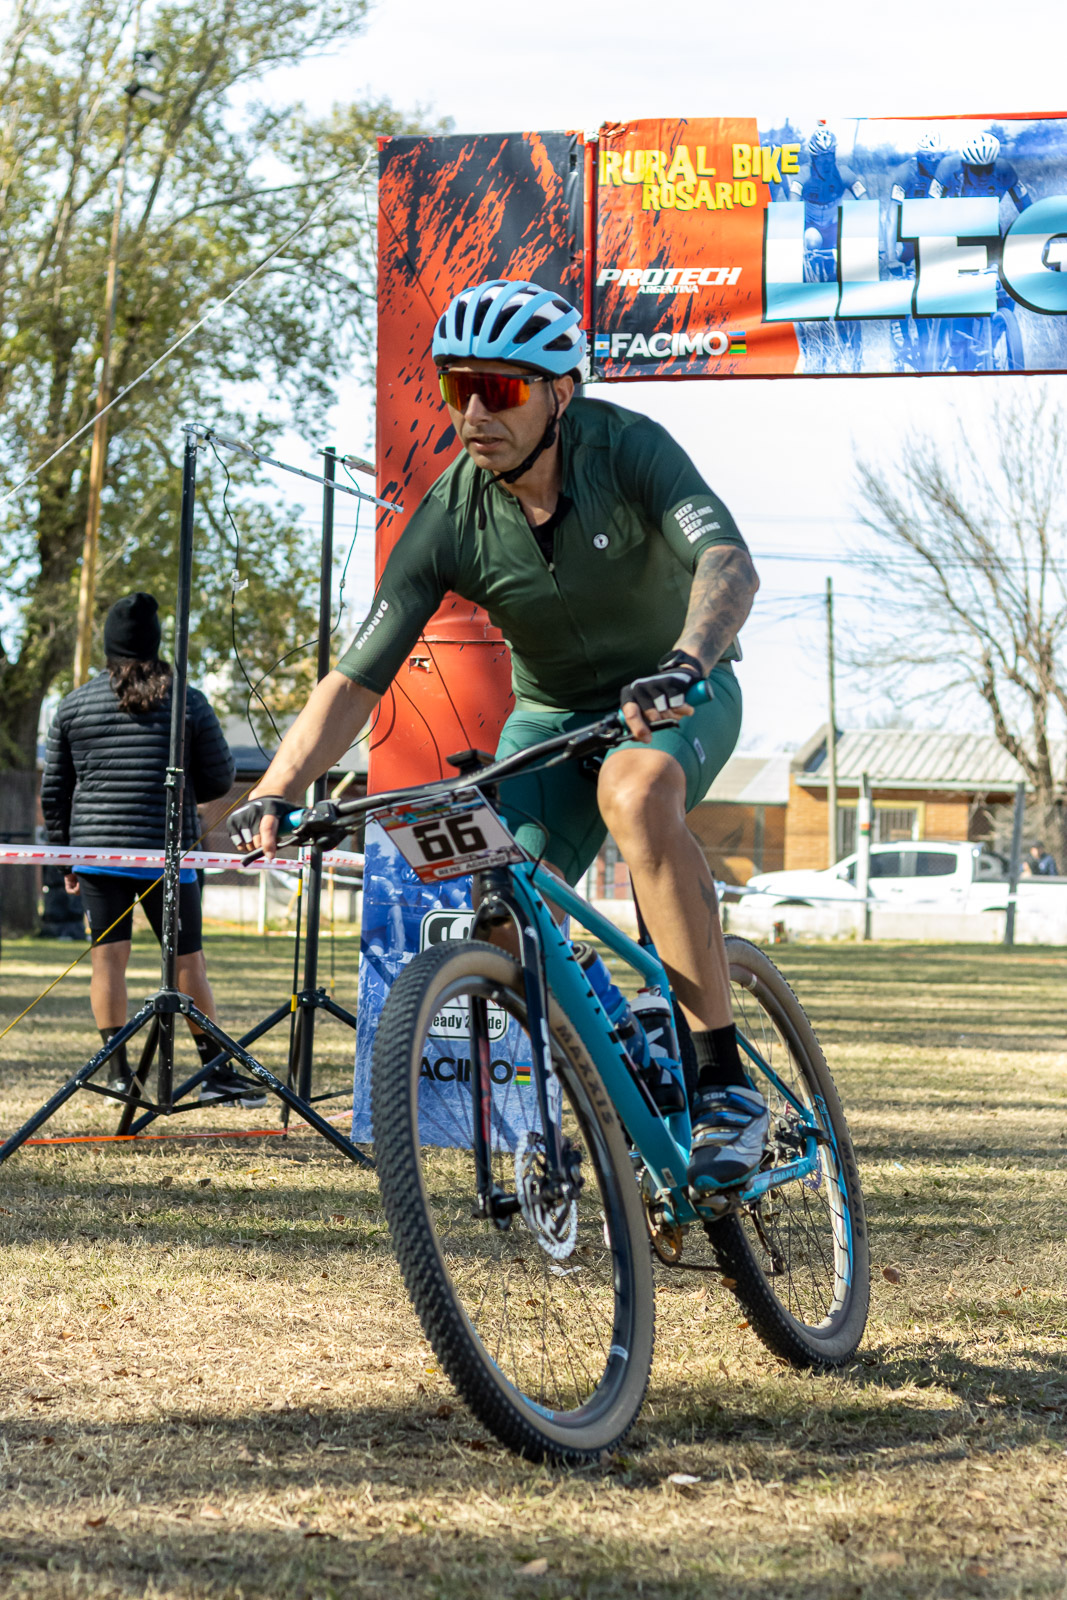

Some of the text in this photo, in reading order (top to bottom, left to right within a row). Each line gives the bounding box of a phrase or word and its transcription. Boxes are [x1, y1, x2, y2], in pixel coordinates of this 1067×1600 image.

[599, 143, 801, 186] RURAL BIKE
[642, 180, 757, 211] ROSARIO
[596, 267, 743, 286] PROTECH
[636, 285, 700, 294] ARGENTINA
[611, 331, 729, 358] FACIMO
[674, 503, 693, 521] KEEP
[682, 518, 703, 536] KEEP
[412, 813, 488, 862] 66
[432, 1014, 462, 1029] eady
[556, 1025, 613, 1124] MAXXIS
[772, 1167, 798, 1184] GIANT
